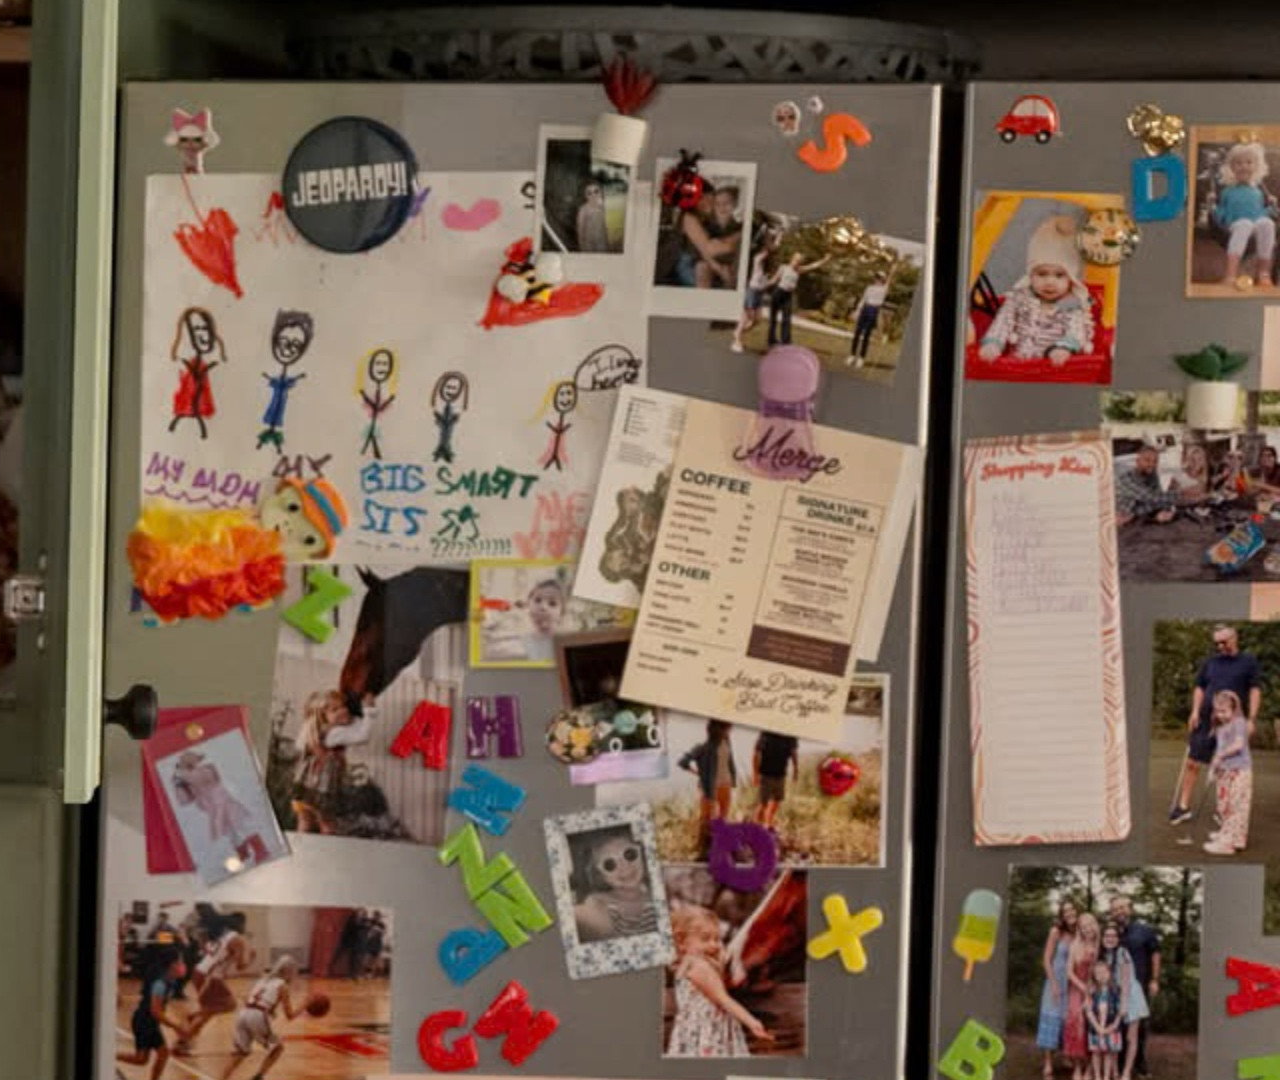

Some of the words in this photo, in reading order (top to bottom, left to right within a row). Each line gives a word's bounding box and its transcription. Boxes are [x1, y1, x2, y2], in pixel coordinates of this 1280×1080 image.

[293, 162, 408, 207] JEOPARDY!
[1131, 153, 1188, 222] D
[733, 424, 842, 484] Merge
[981, 459, 1055, 481] Shopping
[359, 461, 426, 494] BIG
[680, 467, 751, 496] COFFEE
[359, 498, 428, 537] SIS
[797, 494, 869, 520] SIGNATURE
[806, 507, 855, 527] DRINKS
[657, 560, 711, 581] OTHER
[390, 699, 453, 770] A
